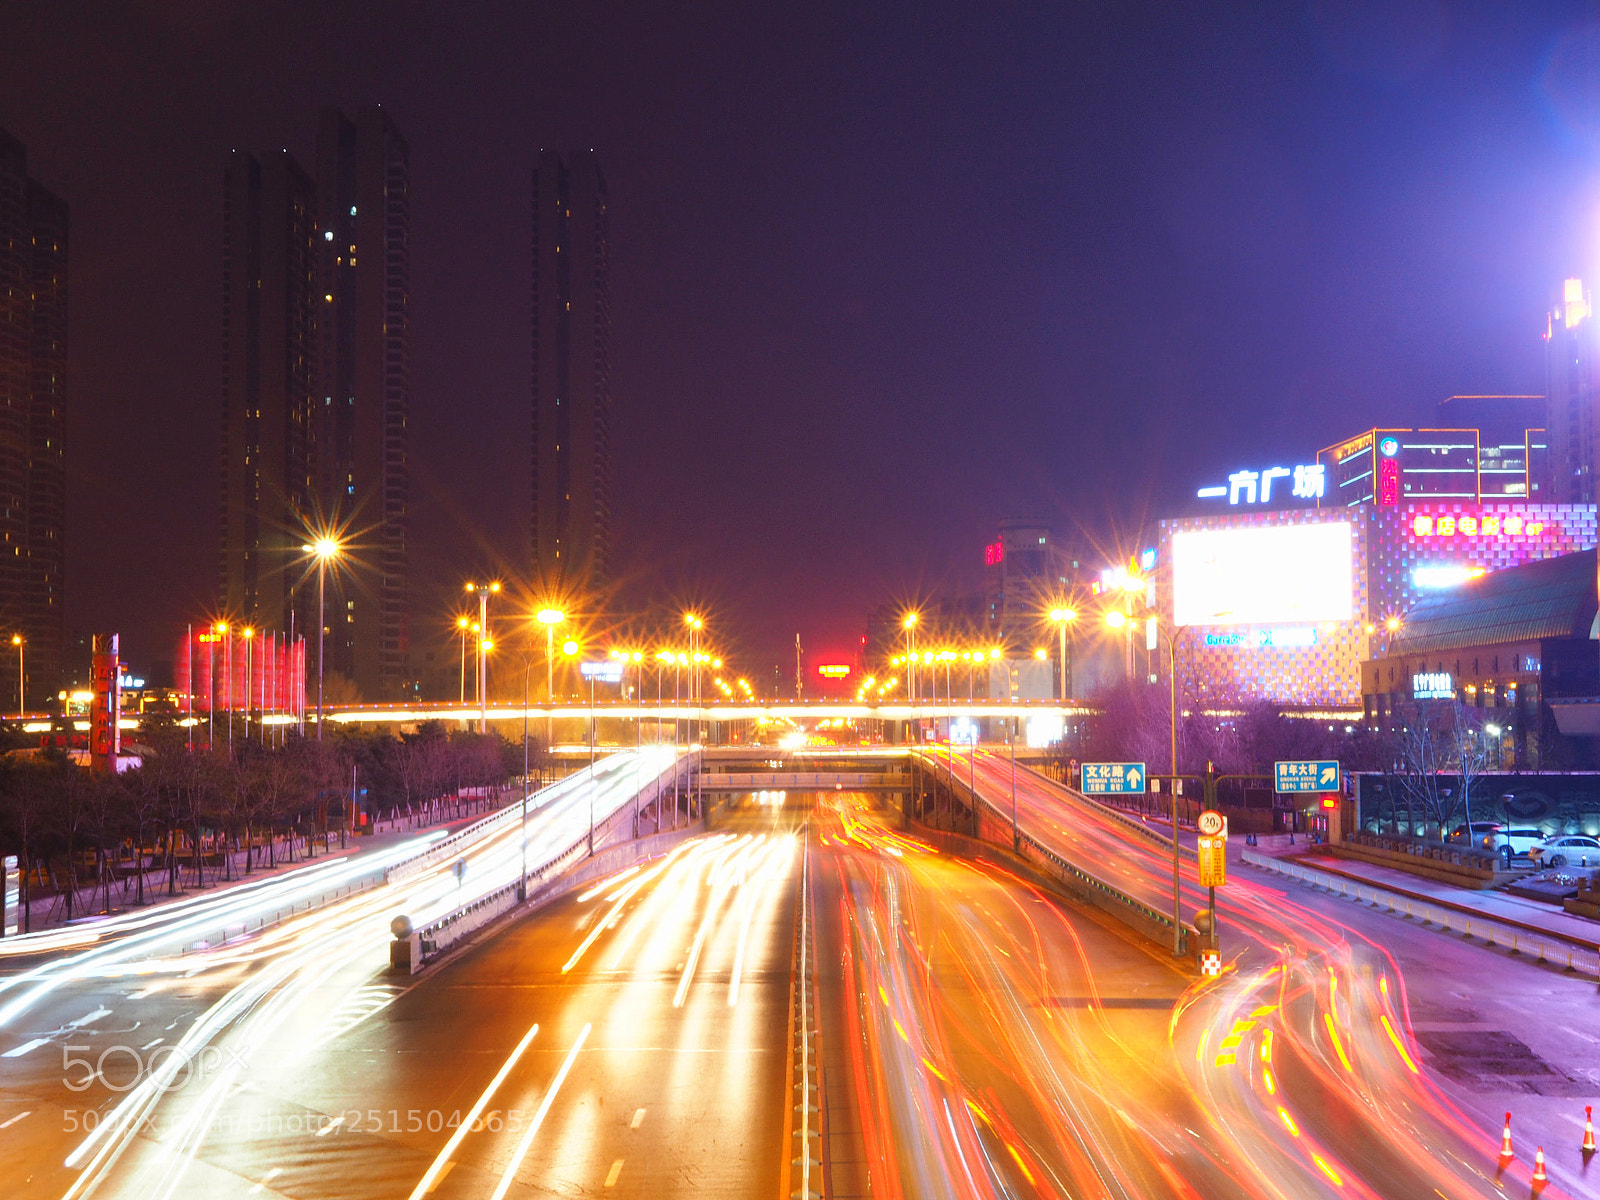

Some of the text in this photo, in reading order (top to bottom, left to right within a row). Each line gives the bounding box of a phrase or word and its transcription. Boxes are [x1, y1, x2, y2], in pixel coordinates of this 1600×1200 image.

[1197, 464, 1325, 505] 一方广场
[1525, 522, 1544, 537] 6F
[1086, 765, 1124, 778] 文化路
[1279, 763, 1318, 776] 青年大街
